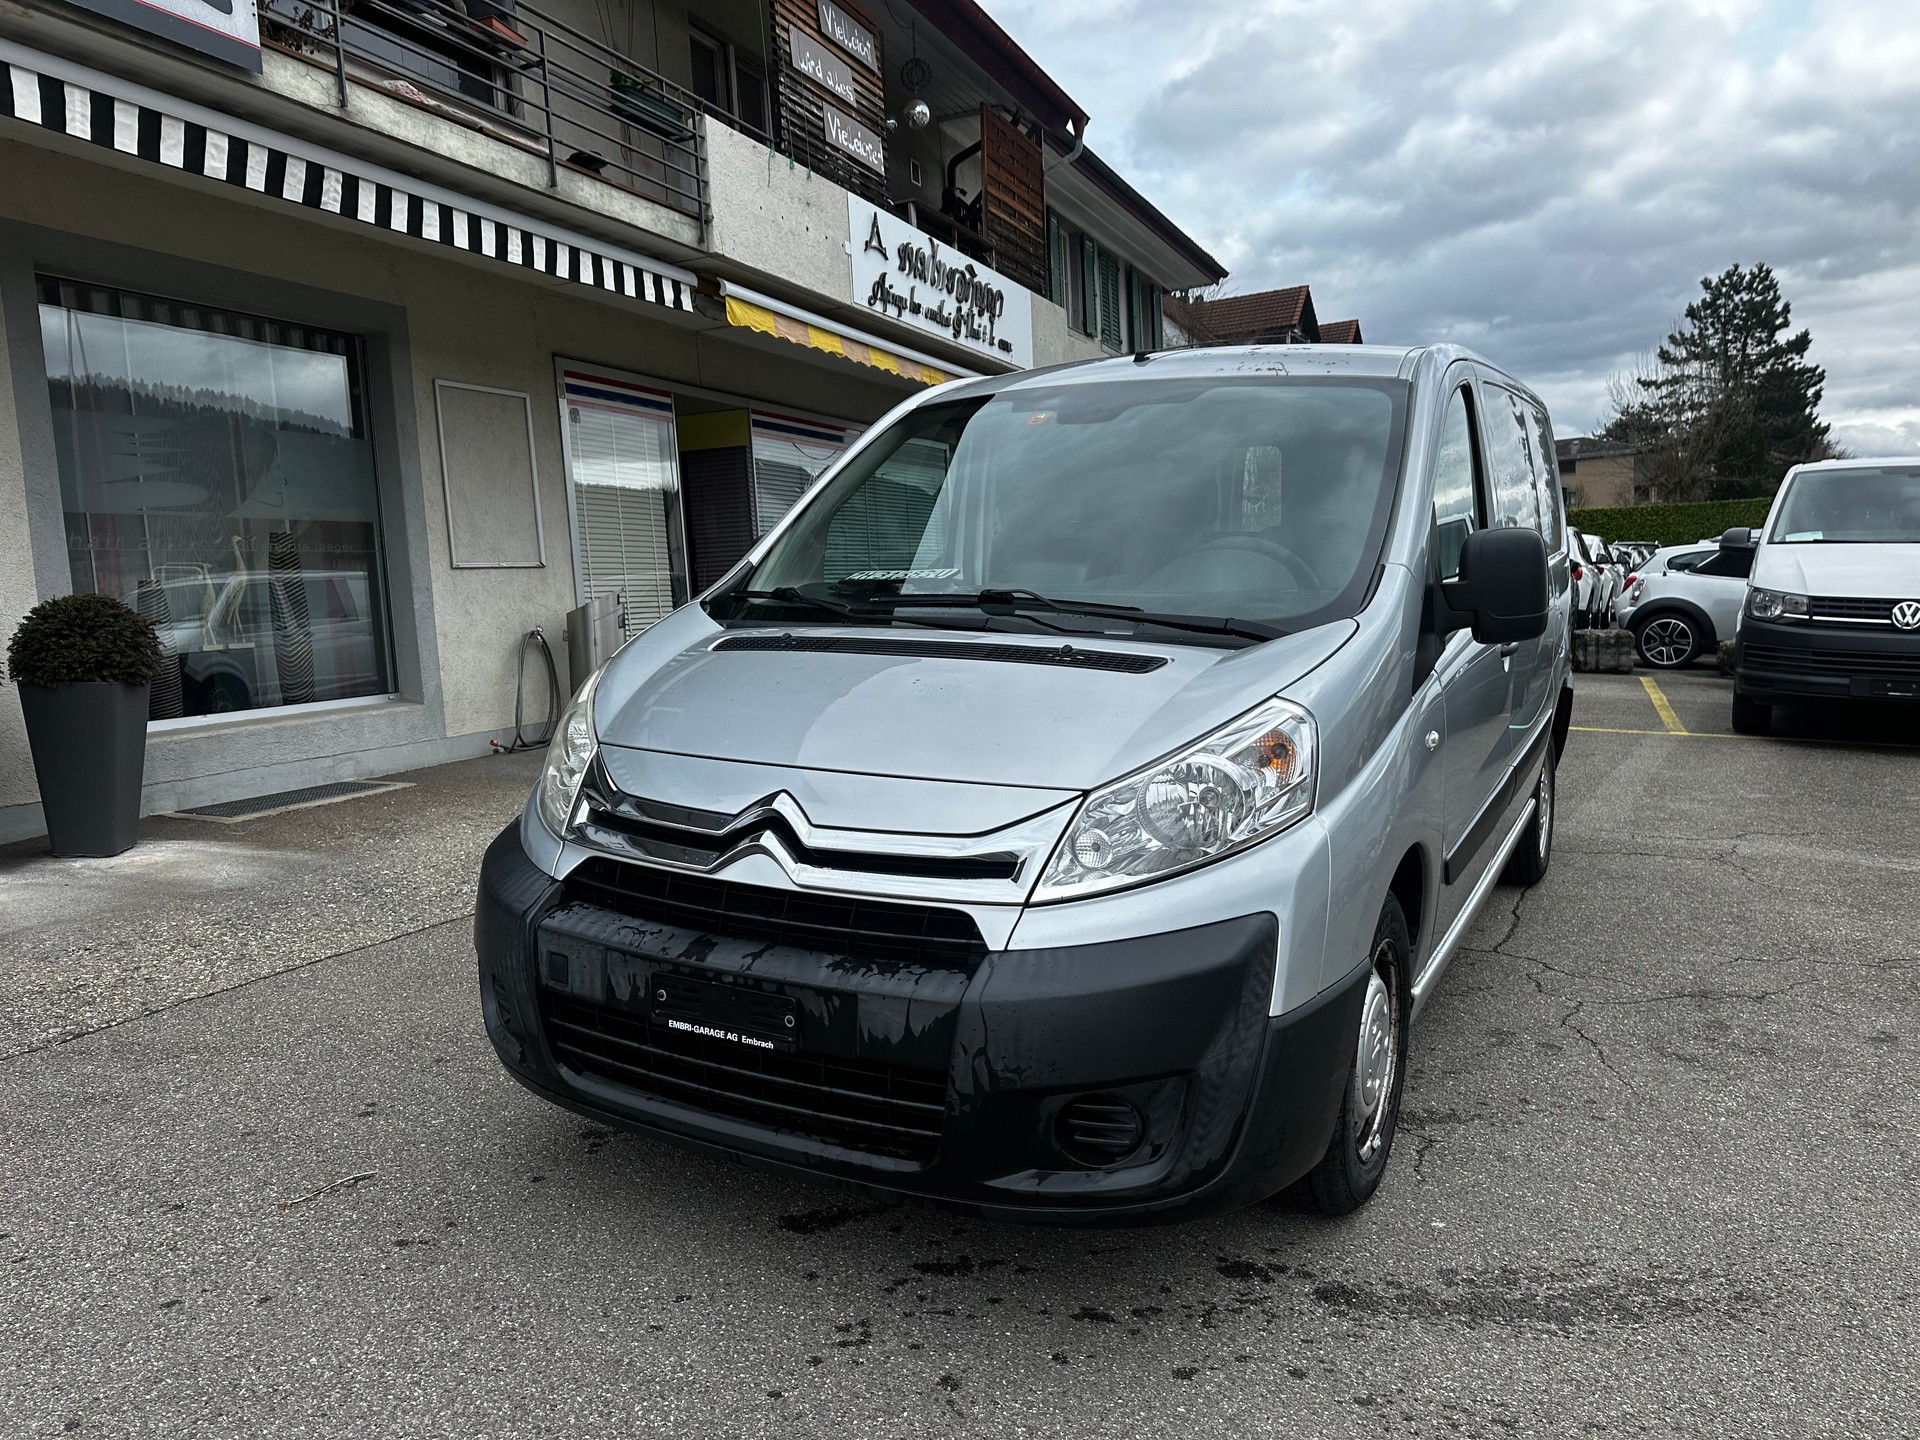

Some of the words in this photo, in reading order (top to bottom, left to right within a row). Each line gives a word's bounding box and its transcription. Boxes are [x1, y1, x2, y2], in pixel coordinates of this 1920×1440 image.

[799, 51, 823, 79] wird
[668, 1019, 725, 1039] EMBRI-GARAGE
[726, 1031, 738, 1042] AG
[741, 1035, 774, 1049] Embrach
